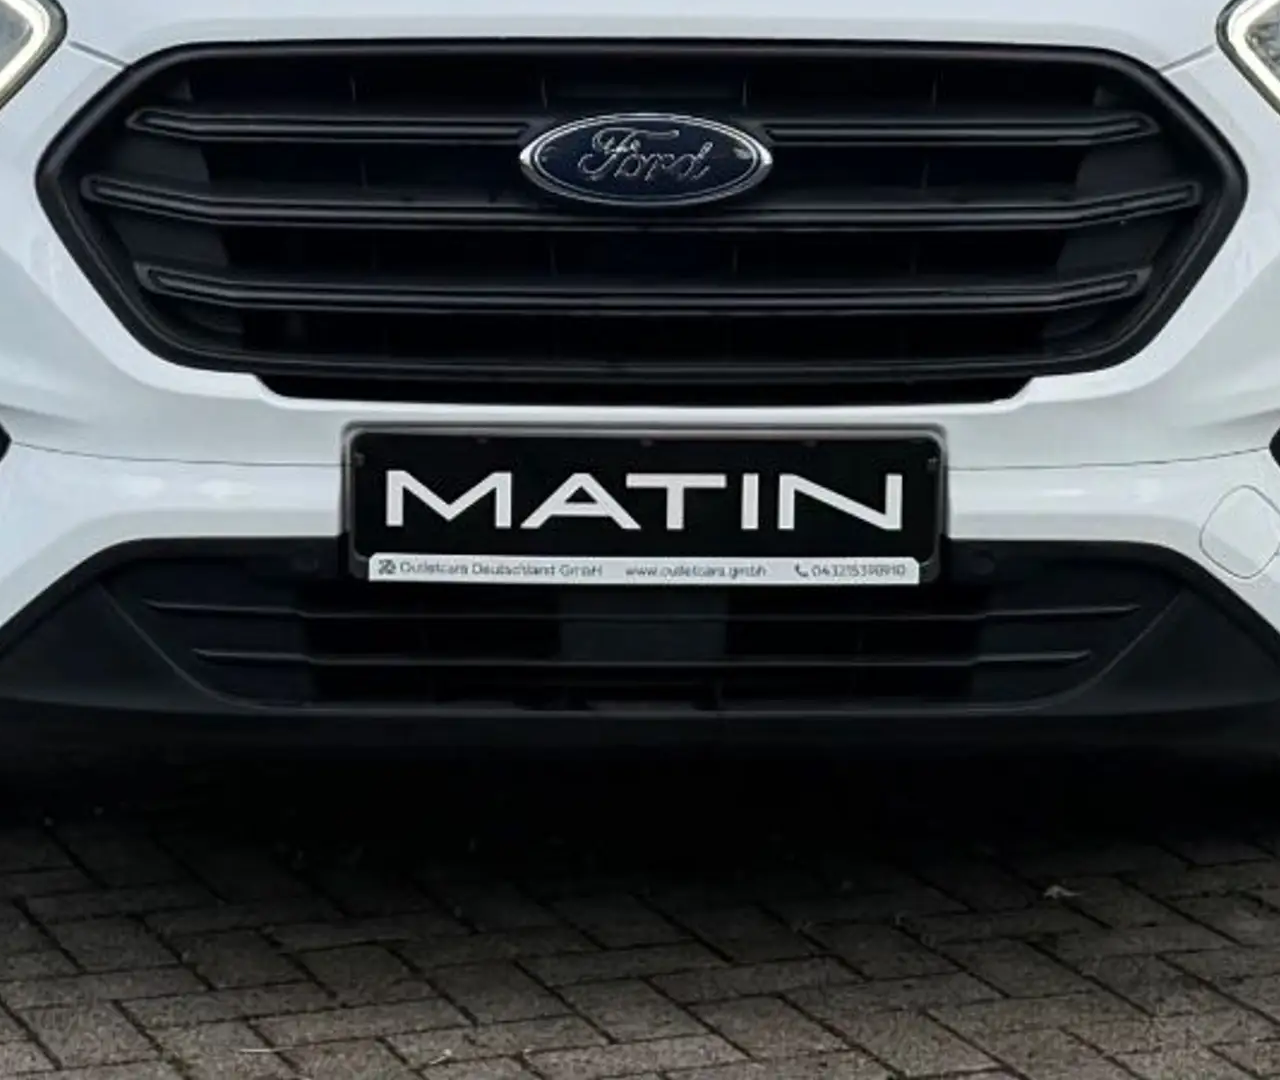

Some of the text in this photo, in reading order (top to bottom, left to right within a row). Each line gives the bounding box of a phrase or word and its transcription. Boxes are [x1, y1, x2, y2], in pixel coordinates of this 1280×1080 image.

[385, 469, 904, 531] MATIN
[471, 562, 557, 578] Deutschland
[558, 563, 603, 578] GmbH
